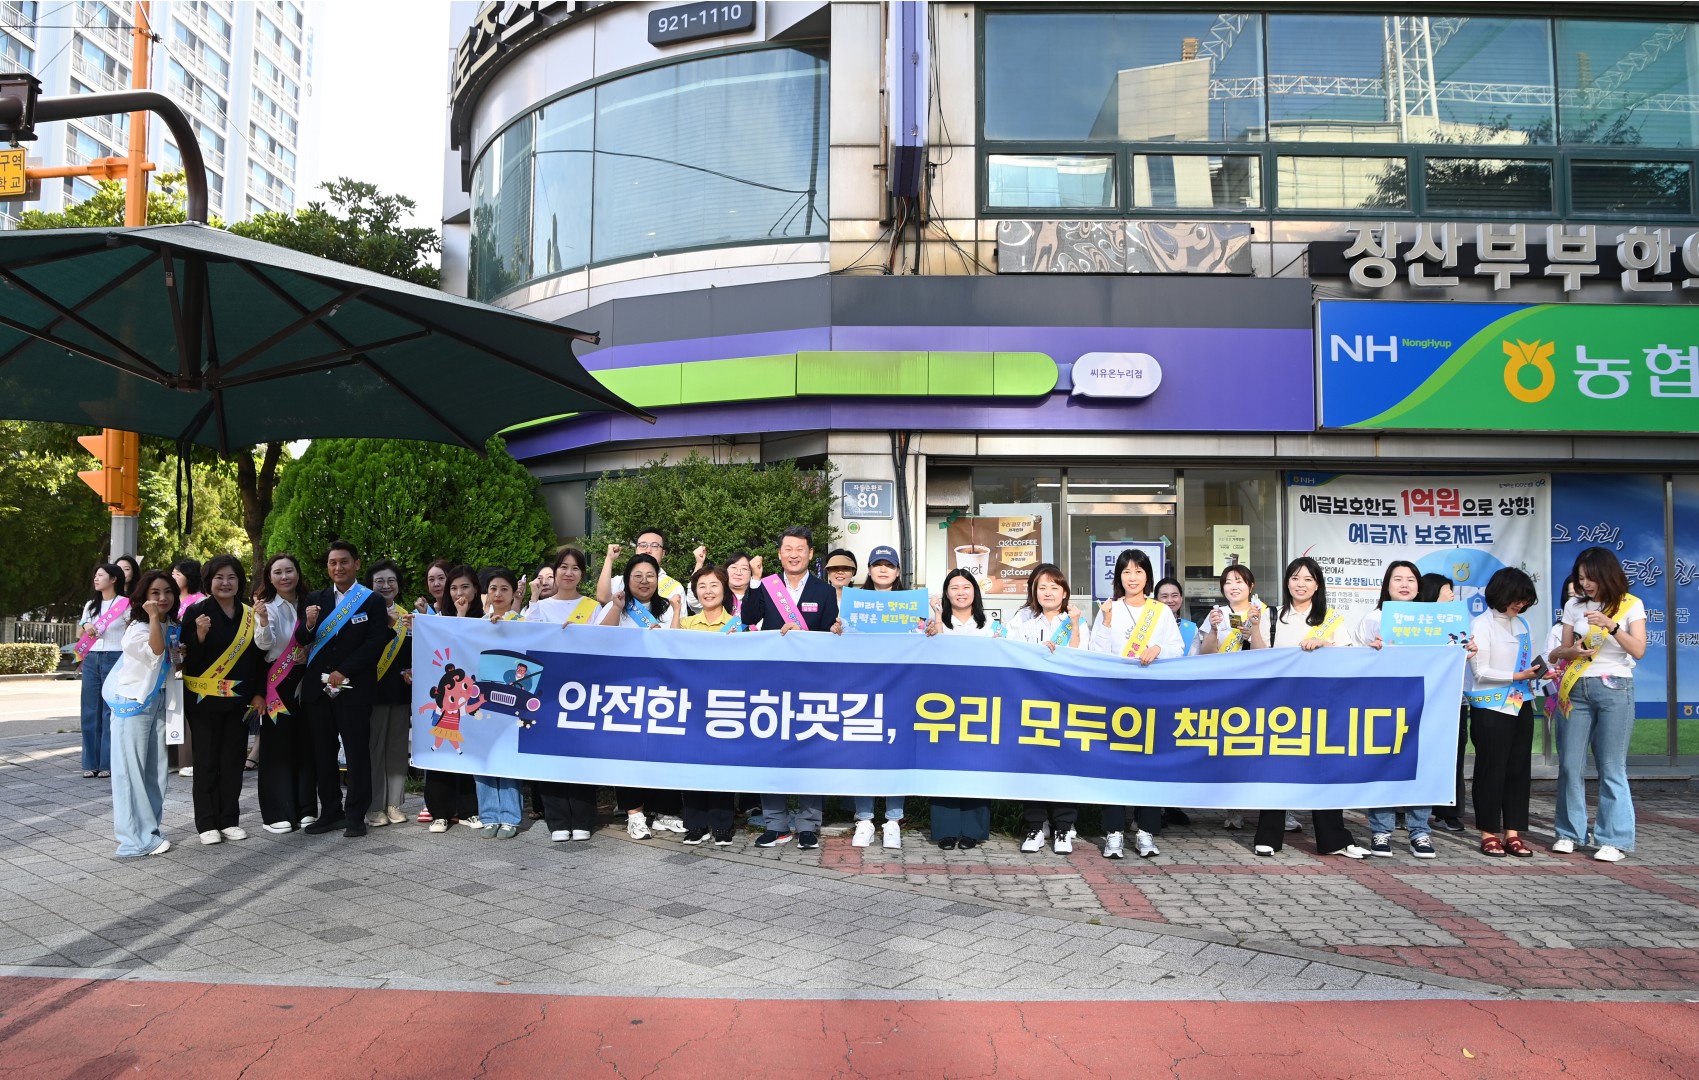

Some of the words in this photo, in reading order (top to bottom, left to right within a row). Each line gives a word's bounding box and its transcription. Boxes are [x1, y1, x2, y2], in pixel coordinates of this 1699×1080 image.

[658, 5, 742, 33] 921-1110
[0, 153, 22, 171] 구역
[1331, 335, 1398, 362] NH
[1402, 338, 1452, 349] NongHyup
[1090, 369, 1142, 379] 씨유온누리점
[1573, 344, 1699, 399] 농협
[858, 493, 878, 508] 80
[1300, 495, 1398, 517] 예금보호한도
[1400, 488, 1494, 517] 1억원으로
[1498, 497, 1535, 515] 상향!
[1348, 522, 1407, 544] 예금자
[1415, 524, 1494, 545] 보호제도
[1551, 524, 1571, 542] 그
[1577, 522, 1624, 550] 자리,
[1312, 556, 1335, 566] 년만에
[1337, 556, 1383, 567] 예금보호한도가
[1622, 557, 1662, 586] 든한
[1674, 558, 1699, 590] 친
[1325, 576, 1342, 586] 으로
[1676, 608, 1690, 623] 꿈
[557, 681, 691, 735] 안전한
[704, 689, 897, 745] 등하굣길,
[913, 692, 1001, 745] 우리
[1018, 700, 1156, 755] 모두의
[1172, 706, 1409, 757] 책임입니다
